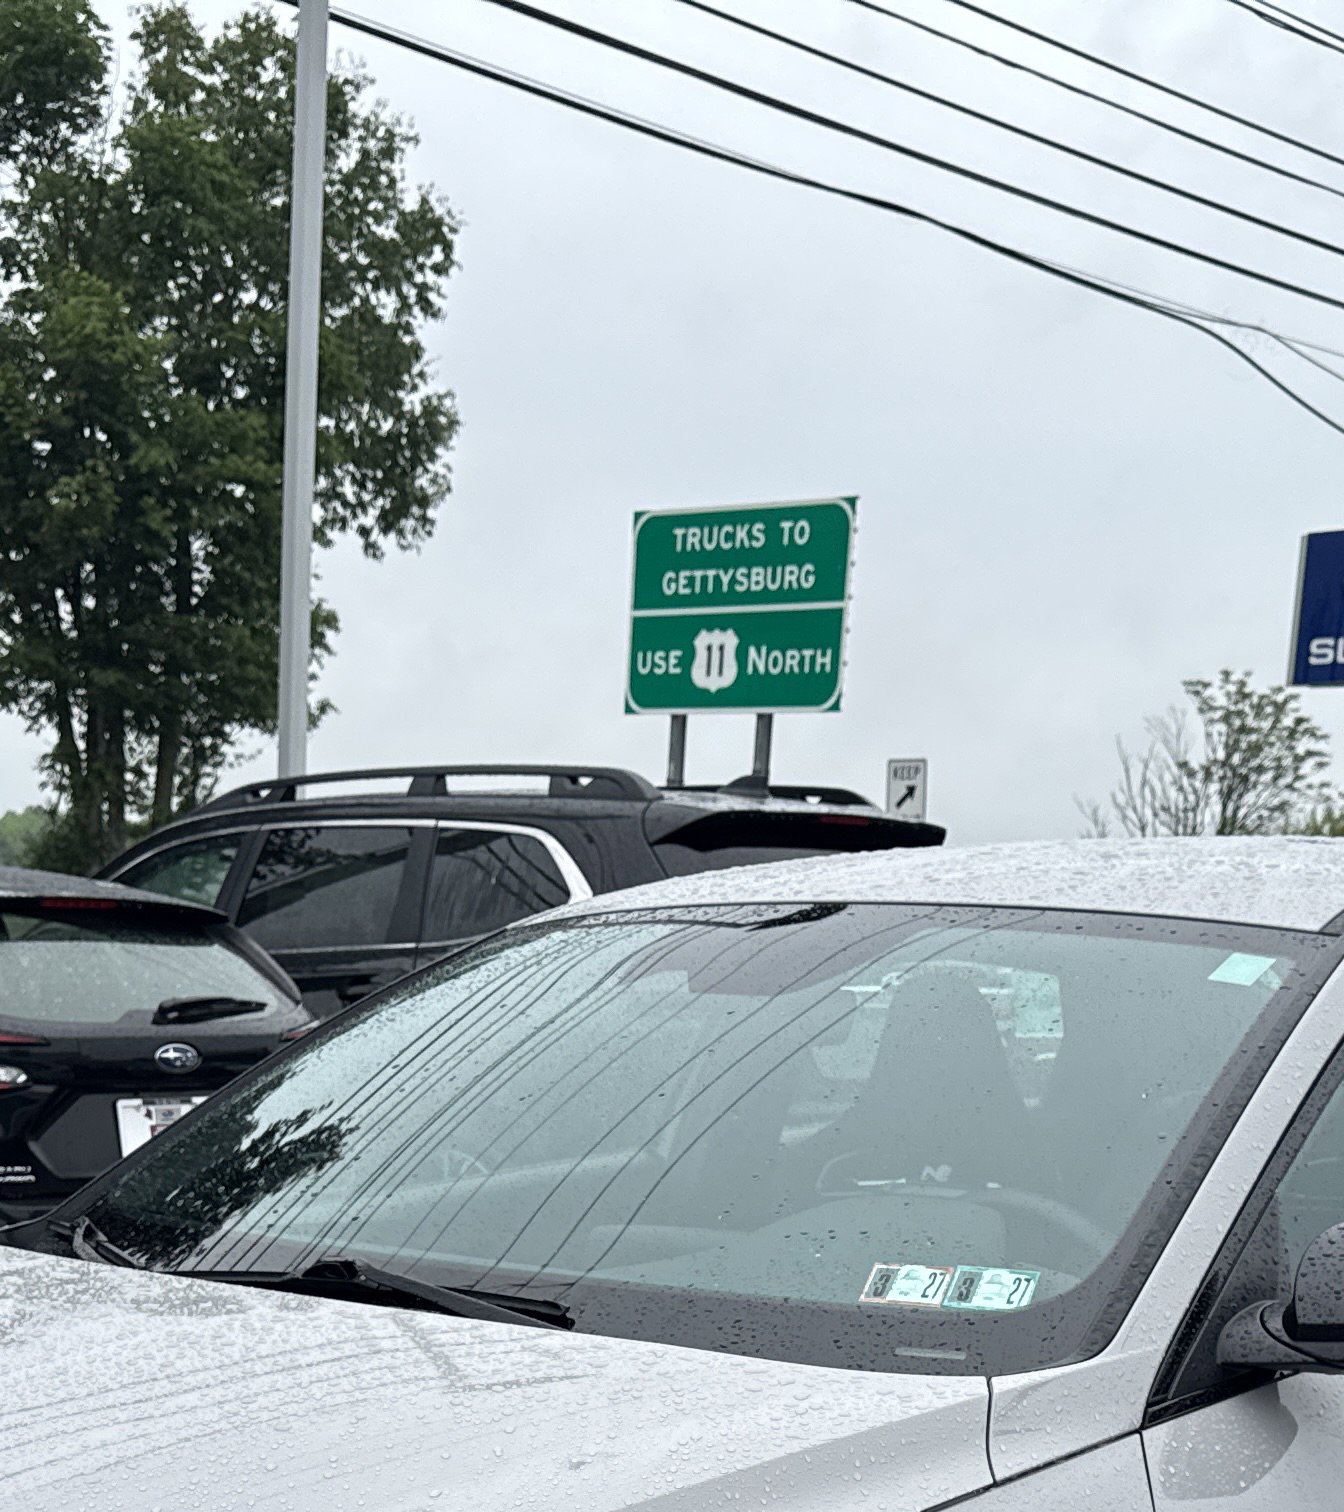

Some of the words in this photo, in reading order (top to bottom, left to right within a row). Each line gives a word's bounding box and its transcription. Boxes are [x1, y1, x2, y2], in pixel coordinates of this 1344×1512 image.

[672, 522, 766, 553] TRUCKS
[779, 519, 811, 547] TO
[661, 562, 816, 597] GETTYSBURG
[636, 650, 683, 675] USE
[706, 643, 725, 678] 11
[746, 645, 832, 676] NORTH
[920, 1271, 947, 1300] 27
[1005, 1276, 1033, 1306] 27
